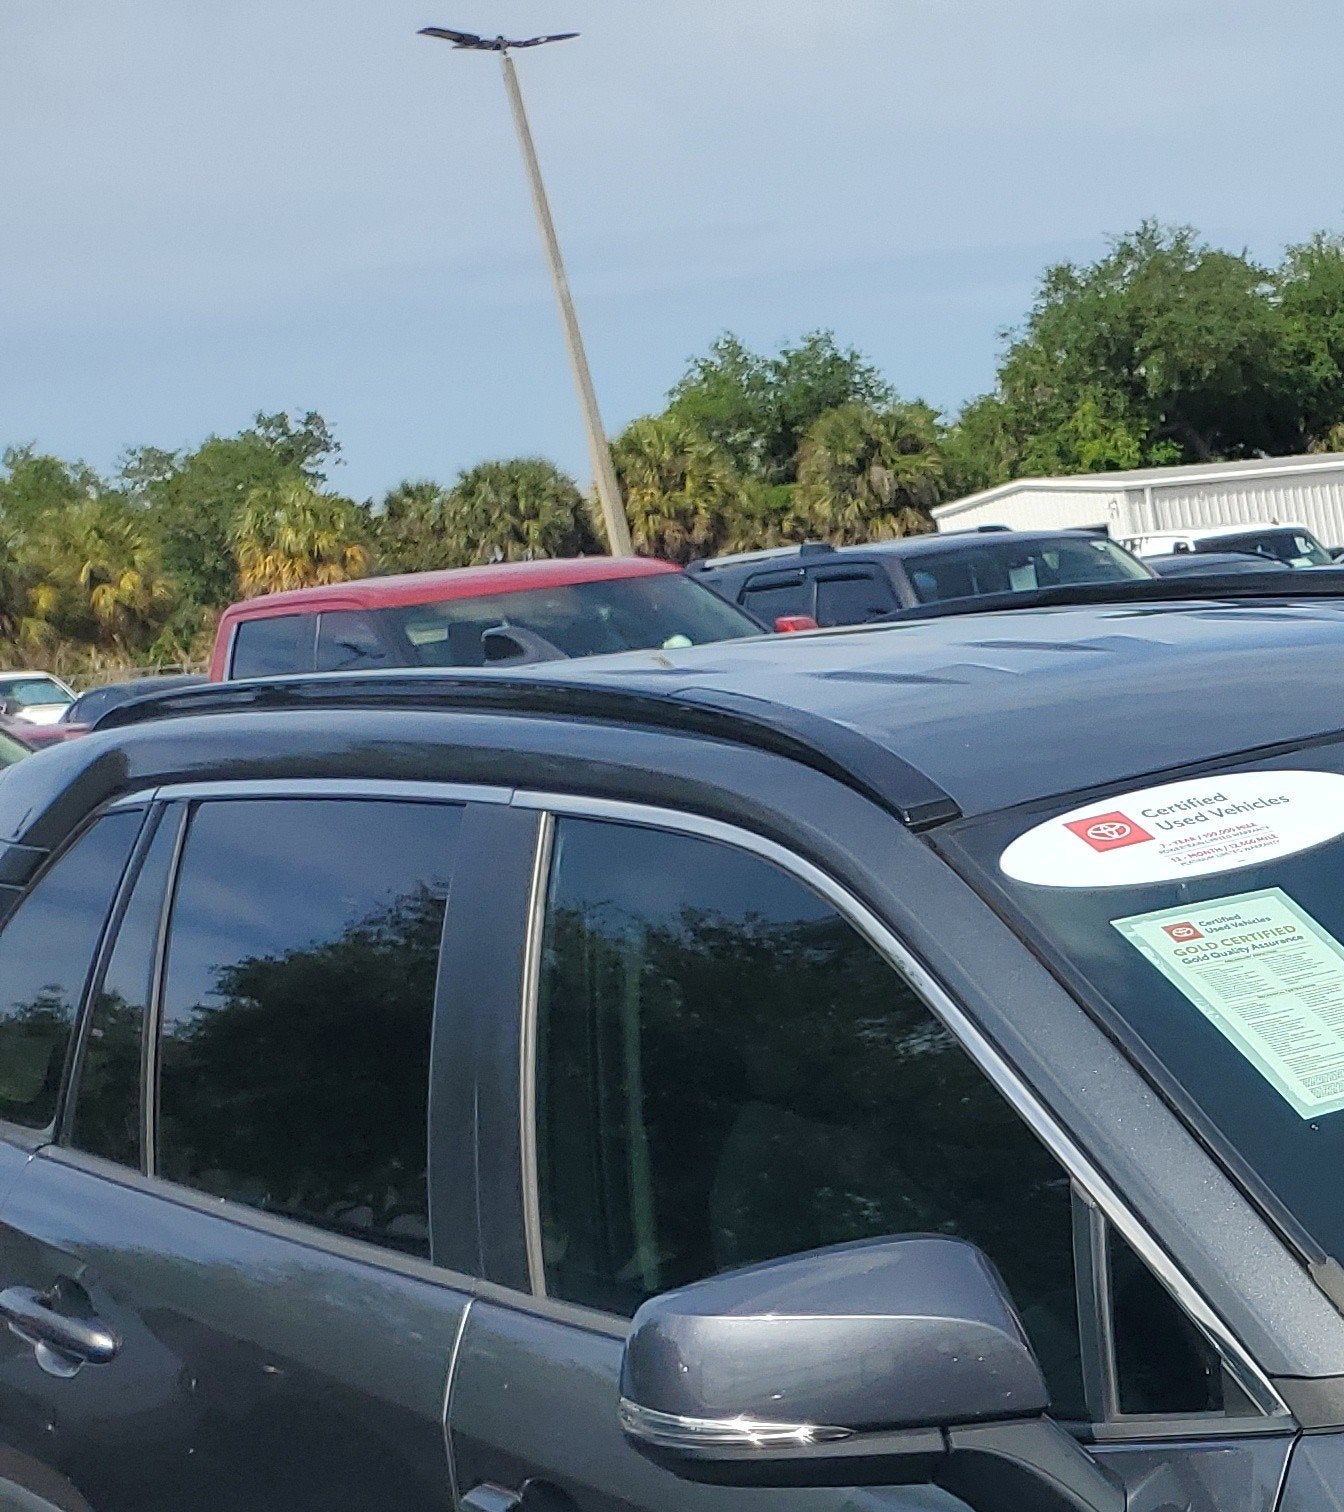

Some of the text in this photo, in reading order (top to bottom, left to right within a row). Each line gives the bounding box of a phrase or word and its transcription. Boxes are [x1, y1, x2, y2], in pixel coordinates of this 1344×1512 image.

[1141, 792, 1228, 818] Certified
[1155, 795, 1290, 830] Used Vehicles
[1199, 914, 1241, 927] Certified
[1205, 916, 1272, 934] Used Vehicles
[1174, 925, 1296, 956] GOLD CERTIFIED
[1182, 954, 1209, 964] Gold
[1210, 947, 1249, 959] Quality
[1251, 935, 1304, 951] Assurance
